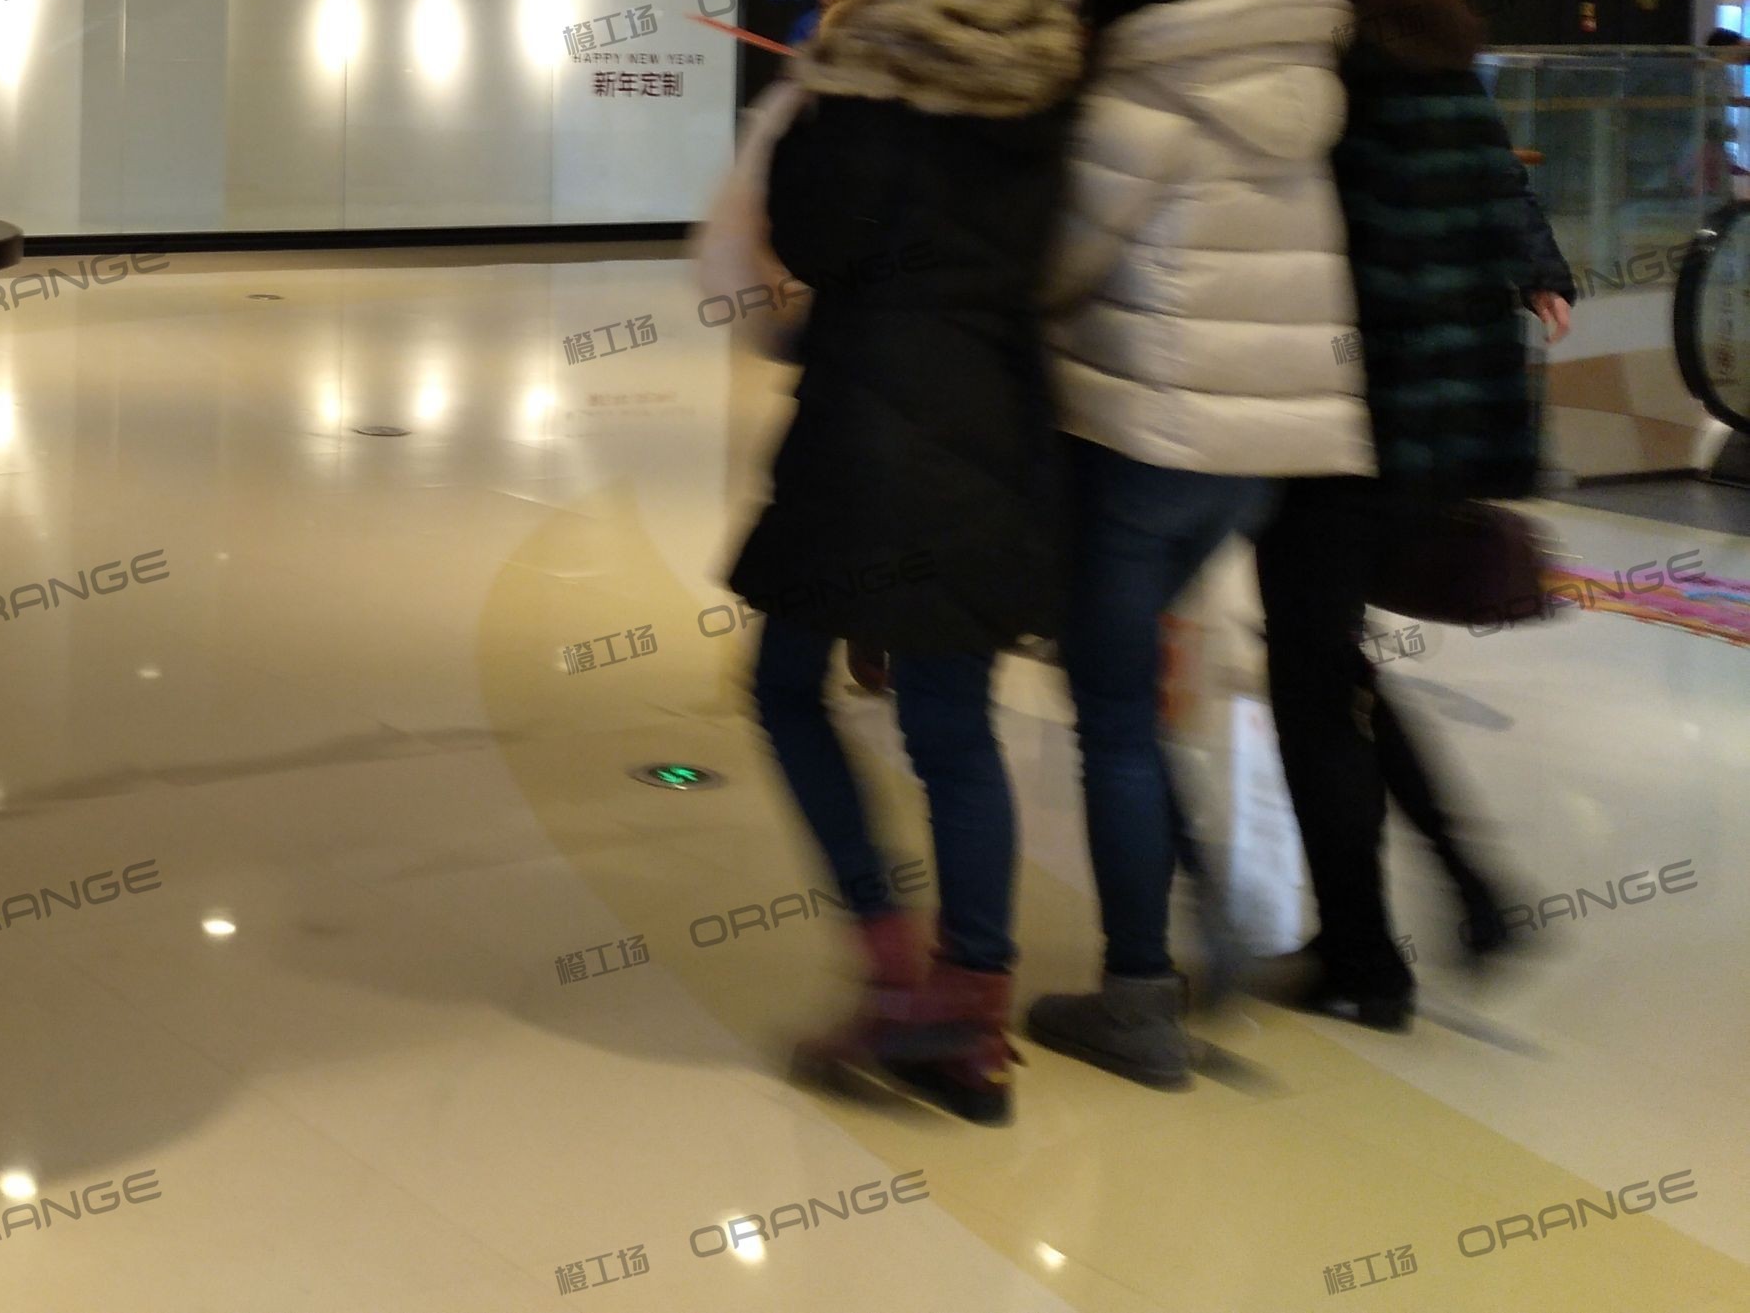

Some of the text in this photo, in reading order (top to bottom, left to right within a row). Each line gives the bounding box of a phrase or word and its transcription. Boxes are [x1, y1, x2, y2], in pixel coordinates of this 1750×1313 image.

[573, 53, 706, 65] HAPPY NEW YEAR
[592, 71, 684, 97] 新年定制
